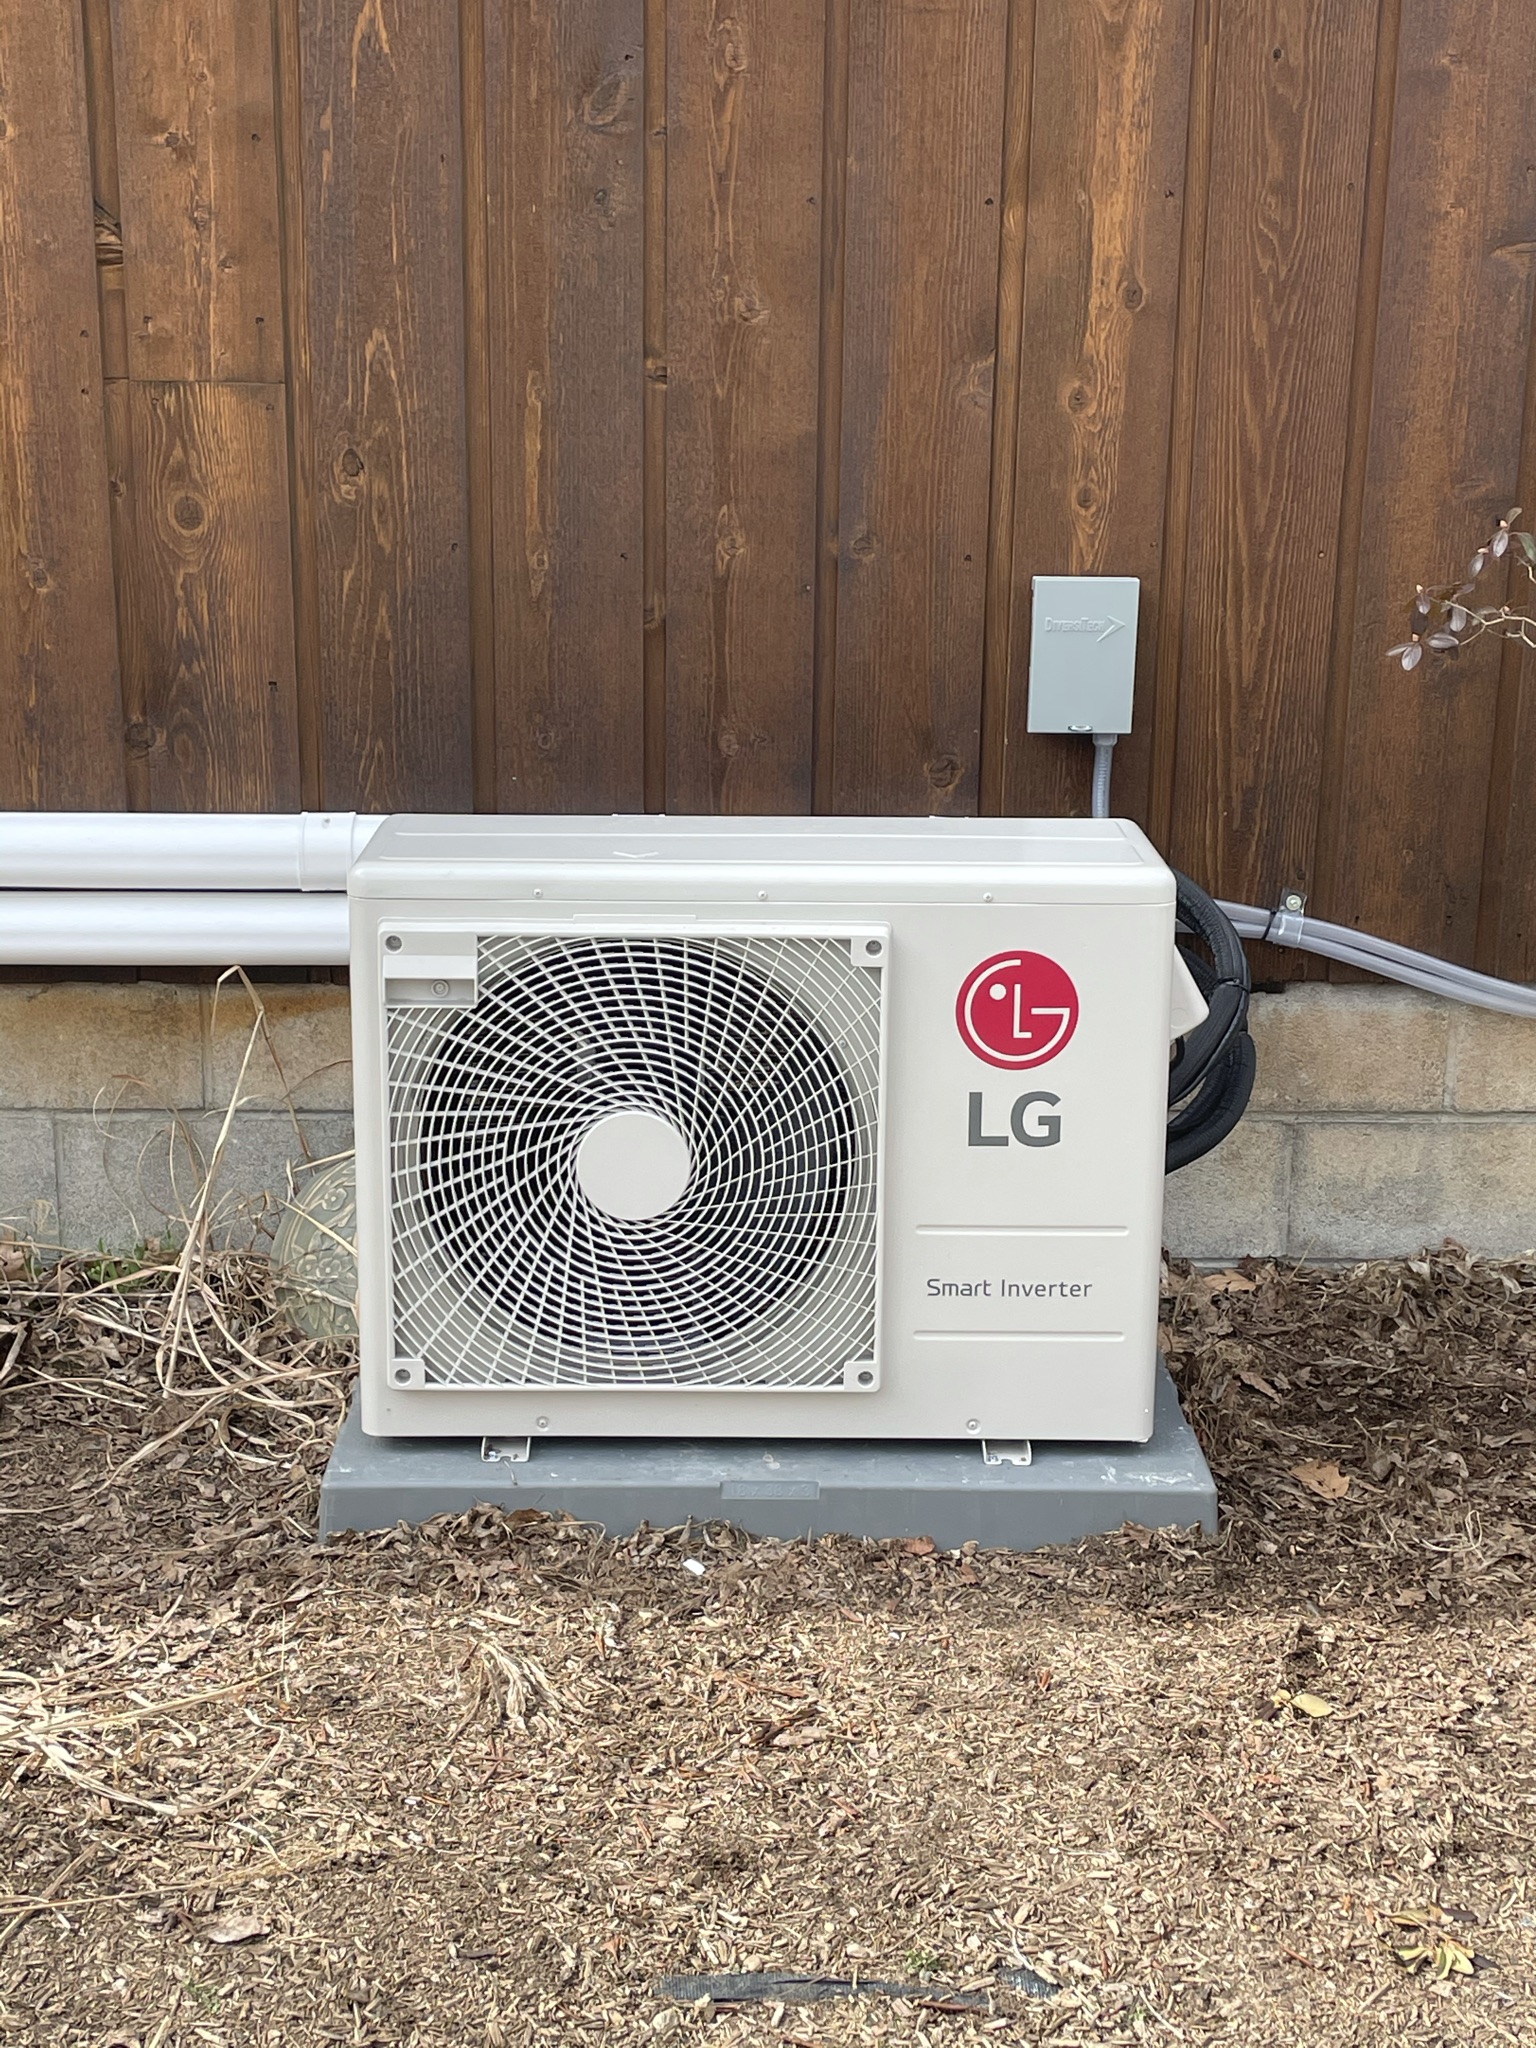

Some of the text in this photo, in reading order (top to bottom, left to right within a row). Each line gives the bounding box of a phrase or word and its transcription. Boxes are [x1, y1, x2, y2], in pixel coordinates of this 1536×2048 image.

[967, 1091, 1062, 1148] LG
[926, 1278, 1094, 1298] Smart Inverter
